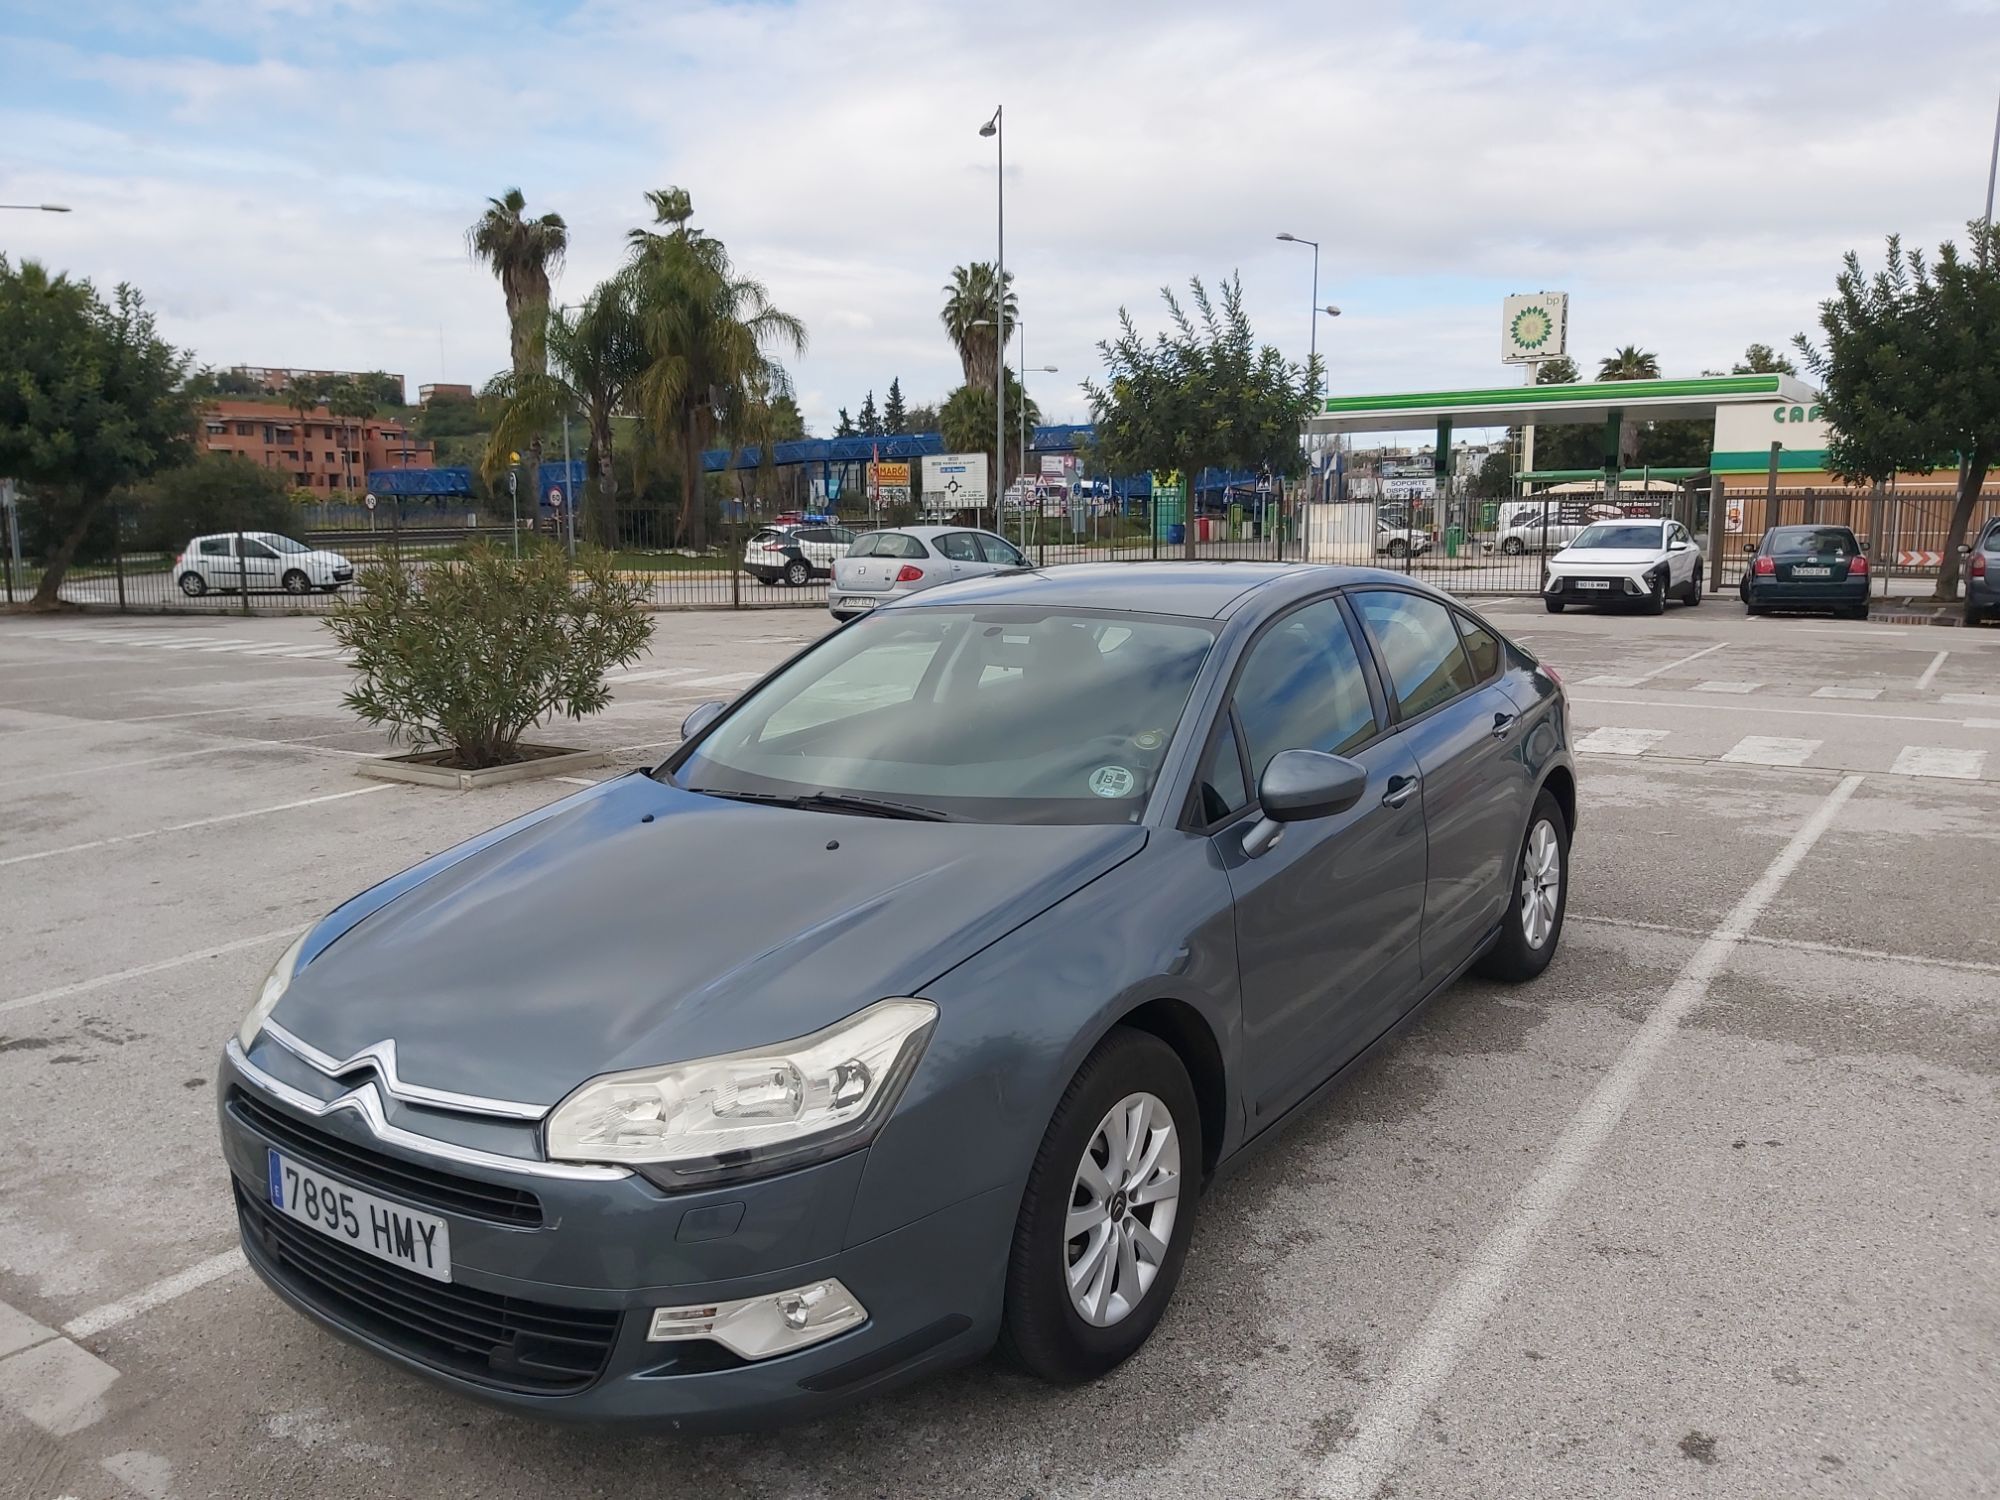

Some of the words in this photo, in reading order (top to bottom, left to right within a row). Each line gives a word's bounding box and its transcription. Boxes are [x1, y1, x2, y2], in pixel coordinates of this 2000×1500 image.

[1546, 295, 1560, 306] bp
[286, 1166, 360, 1239] 7895
[370, 1204, 437, 1269] HMY
